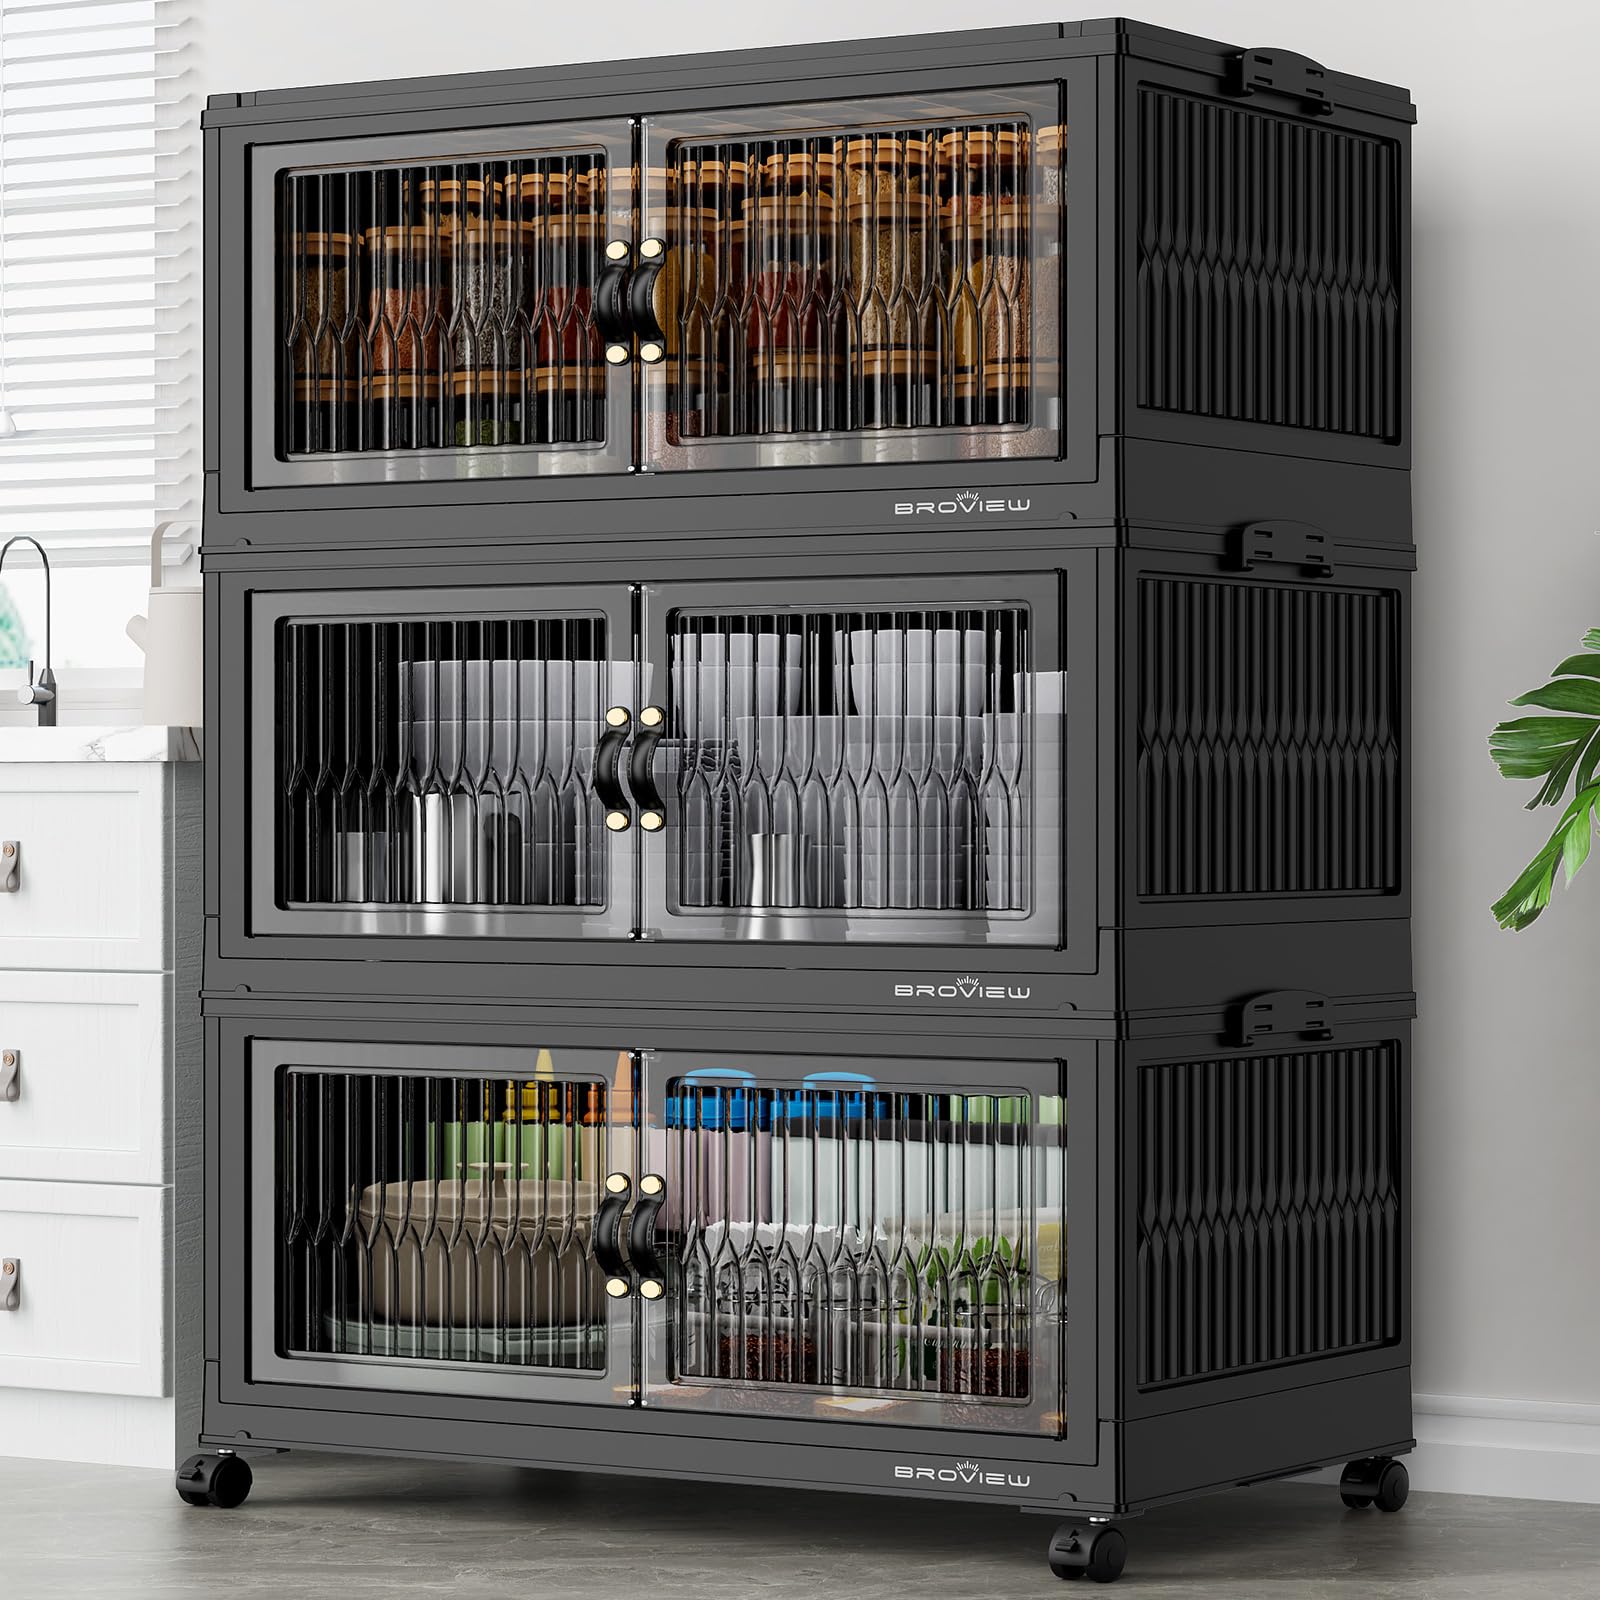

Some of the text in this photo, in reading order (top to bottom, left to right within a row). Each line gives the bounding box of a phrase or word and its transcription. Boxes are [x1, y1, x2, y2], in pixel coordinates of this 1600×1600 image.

[894, 491, 1030, 515] BROVIEW
[894, 975, 1030, 999] BROVIEW
[894, 1460, 1030, 1487] BROVIEW
